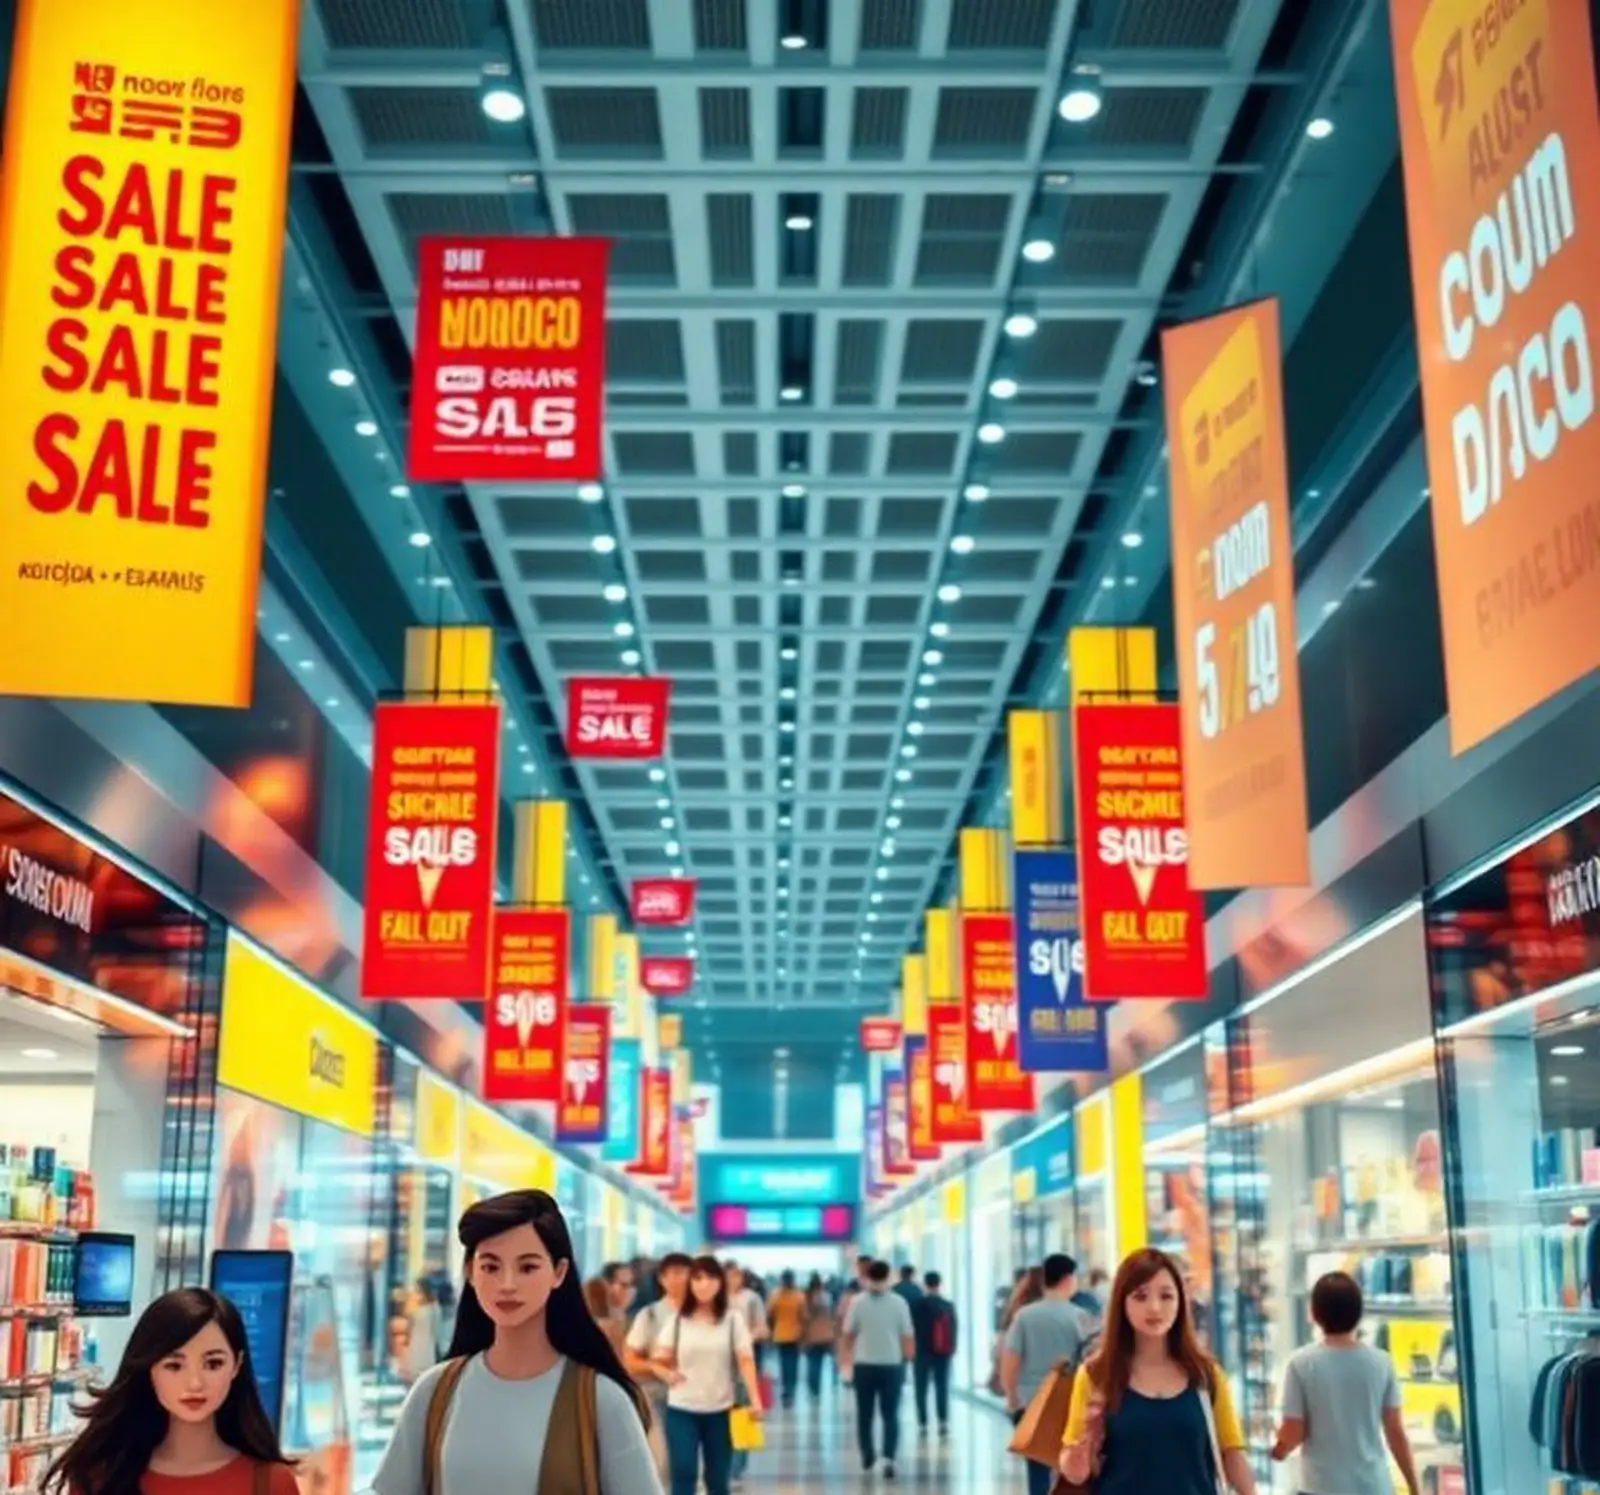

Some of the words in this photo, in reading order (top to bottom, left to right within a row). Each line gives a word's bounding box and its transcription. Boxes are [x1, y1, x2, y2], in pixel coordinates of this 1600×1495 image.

[57, 154, 237, 255] SALE
[51, 245, 228, 326] SALE
[41, 318, 223, 407] SALE
[26, 412, 217, 529] SALE
